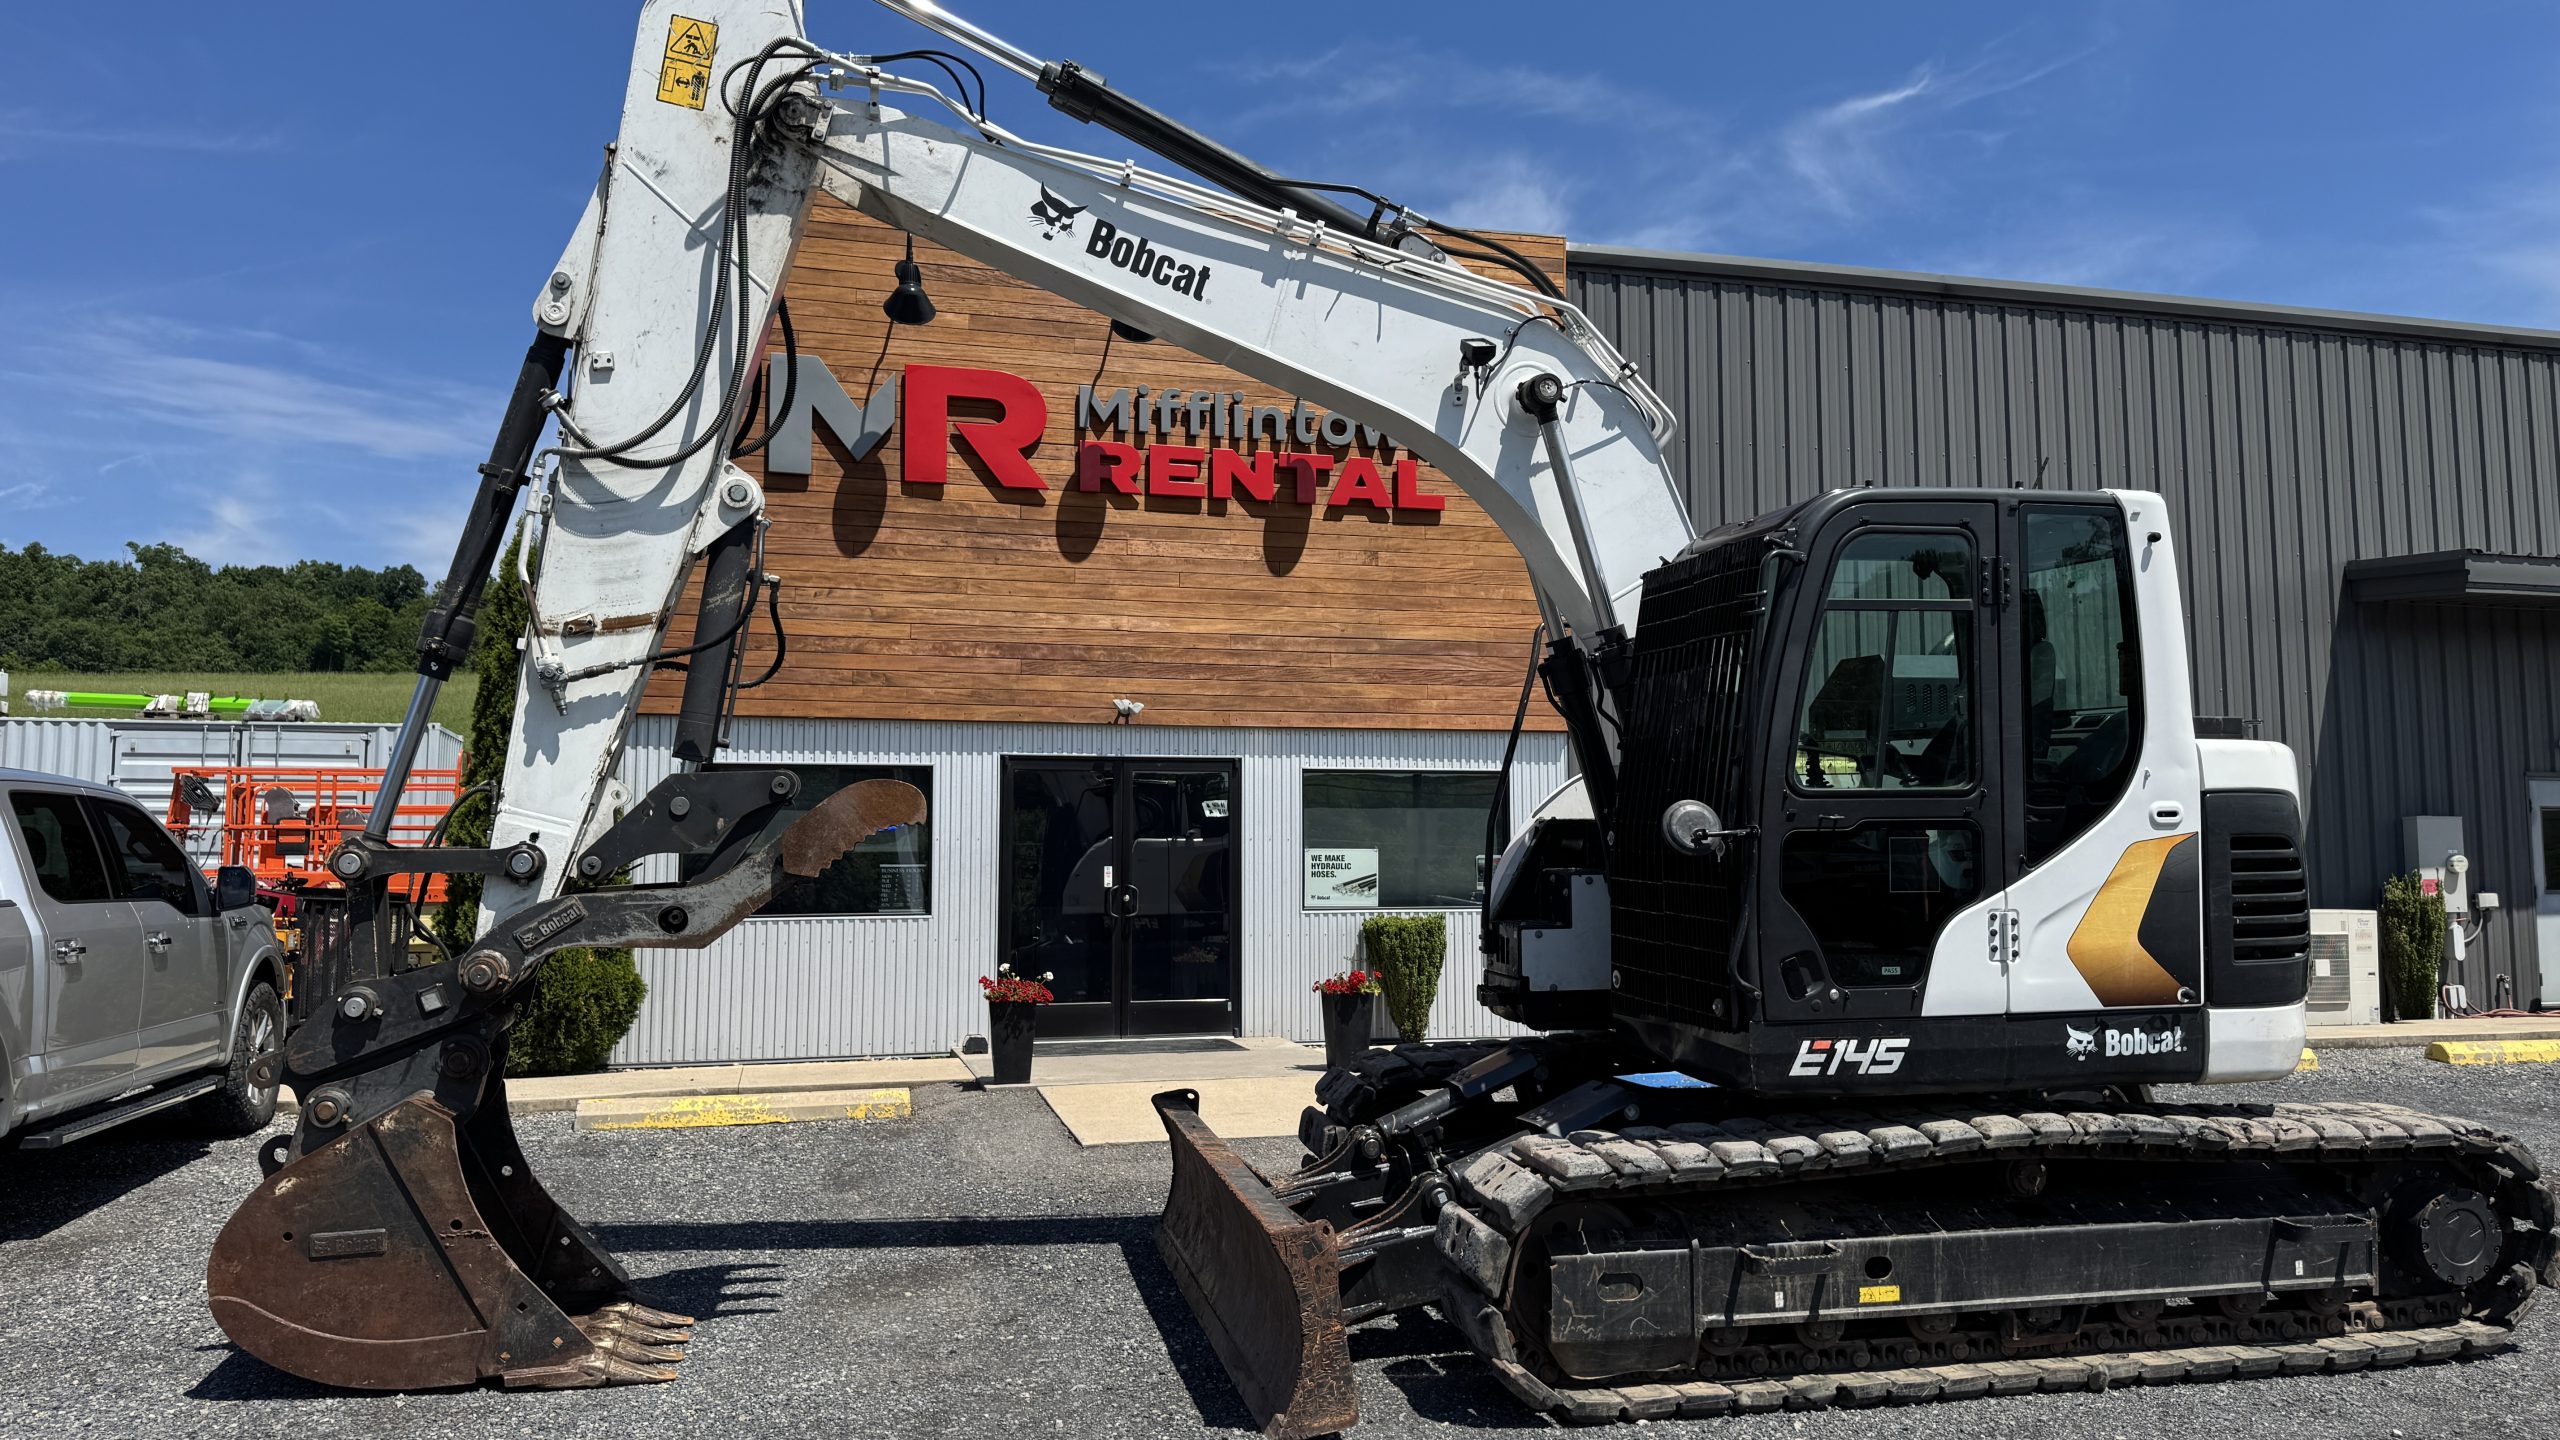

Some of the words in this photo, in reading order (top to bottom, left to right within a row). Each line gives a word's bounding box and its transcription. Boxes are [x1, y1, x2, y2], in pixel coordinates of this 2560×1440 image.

[1085, 218, 1211, 302] Bobcat
[768, 352, 1050, 490] MR
[1079, 440, 1446, 511] RENTAL
[1311, 854, 1323, 862] WE
[1324, 854, 1346, 862] MAKE
[1311, 862, 1352, 870] HYDRAULIC
[1311, 870, 1337, 878] HOSES.
[538, 905, 581, 936] Bobcat
[1788, 1038, 1911, 1076] E145
[2105, 1026, 2183, 1057] Bobcat
